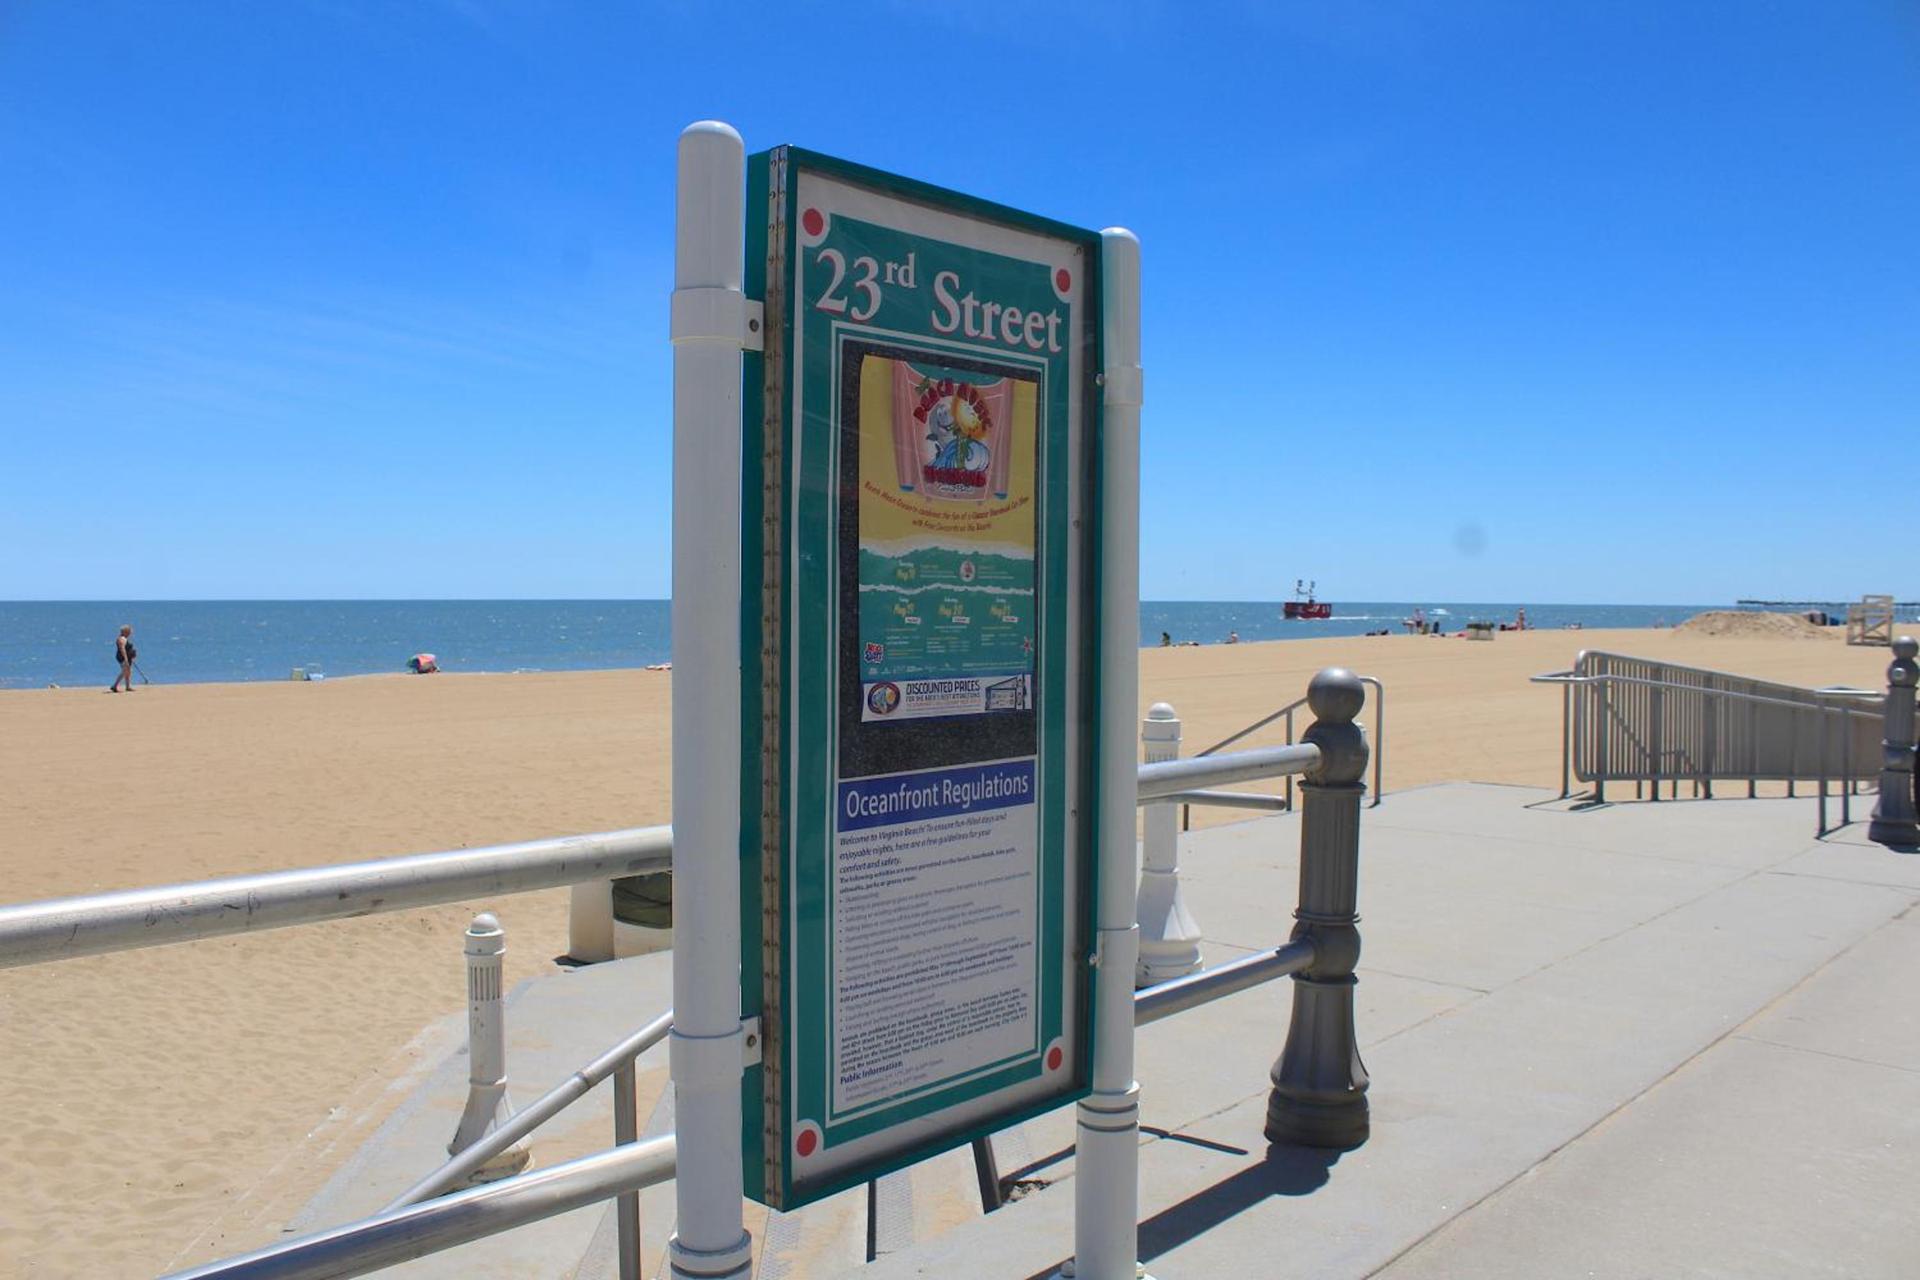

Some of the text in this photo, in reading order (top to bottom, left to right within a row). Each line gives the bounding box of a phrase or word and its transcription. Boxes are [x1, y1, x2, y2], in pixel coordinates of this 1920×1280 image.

[815, 248, 1062, 352] 23rd Street
[905, 680, 980, 695] DISCOUNTED PRICES
[846, 772, 1029, 818] Oceanfront Regulations
[839, 836, 869, 846] Welcome
[870, 833, 877, 841] to
[878, 829, 903, 841] Virginia
[839, 848, 871, 861] enjoyable
[895, 843, 909, 851] here
[839, 863, 866, 874] comfort
[866, 860, 880, 869] and
[839, 1060, 903, 1085] Public Information
